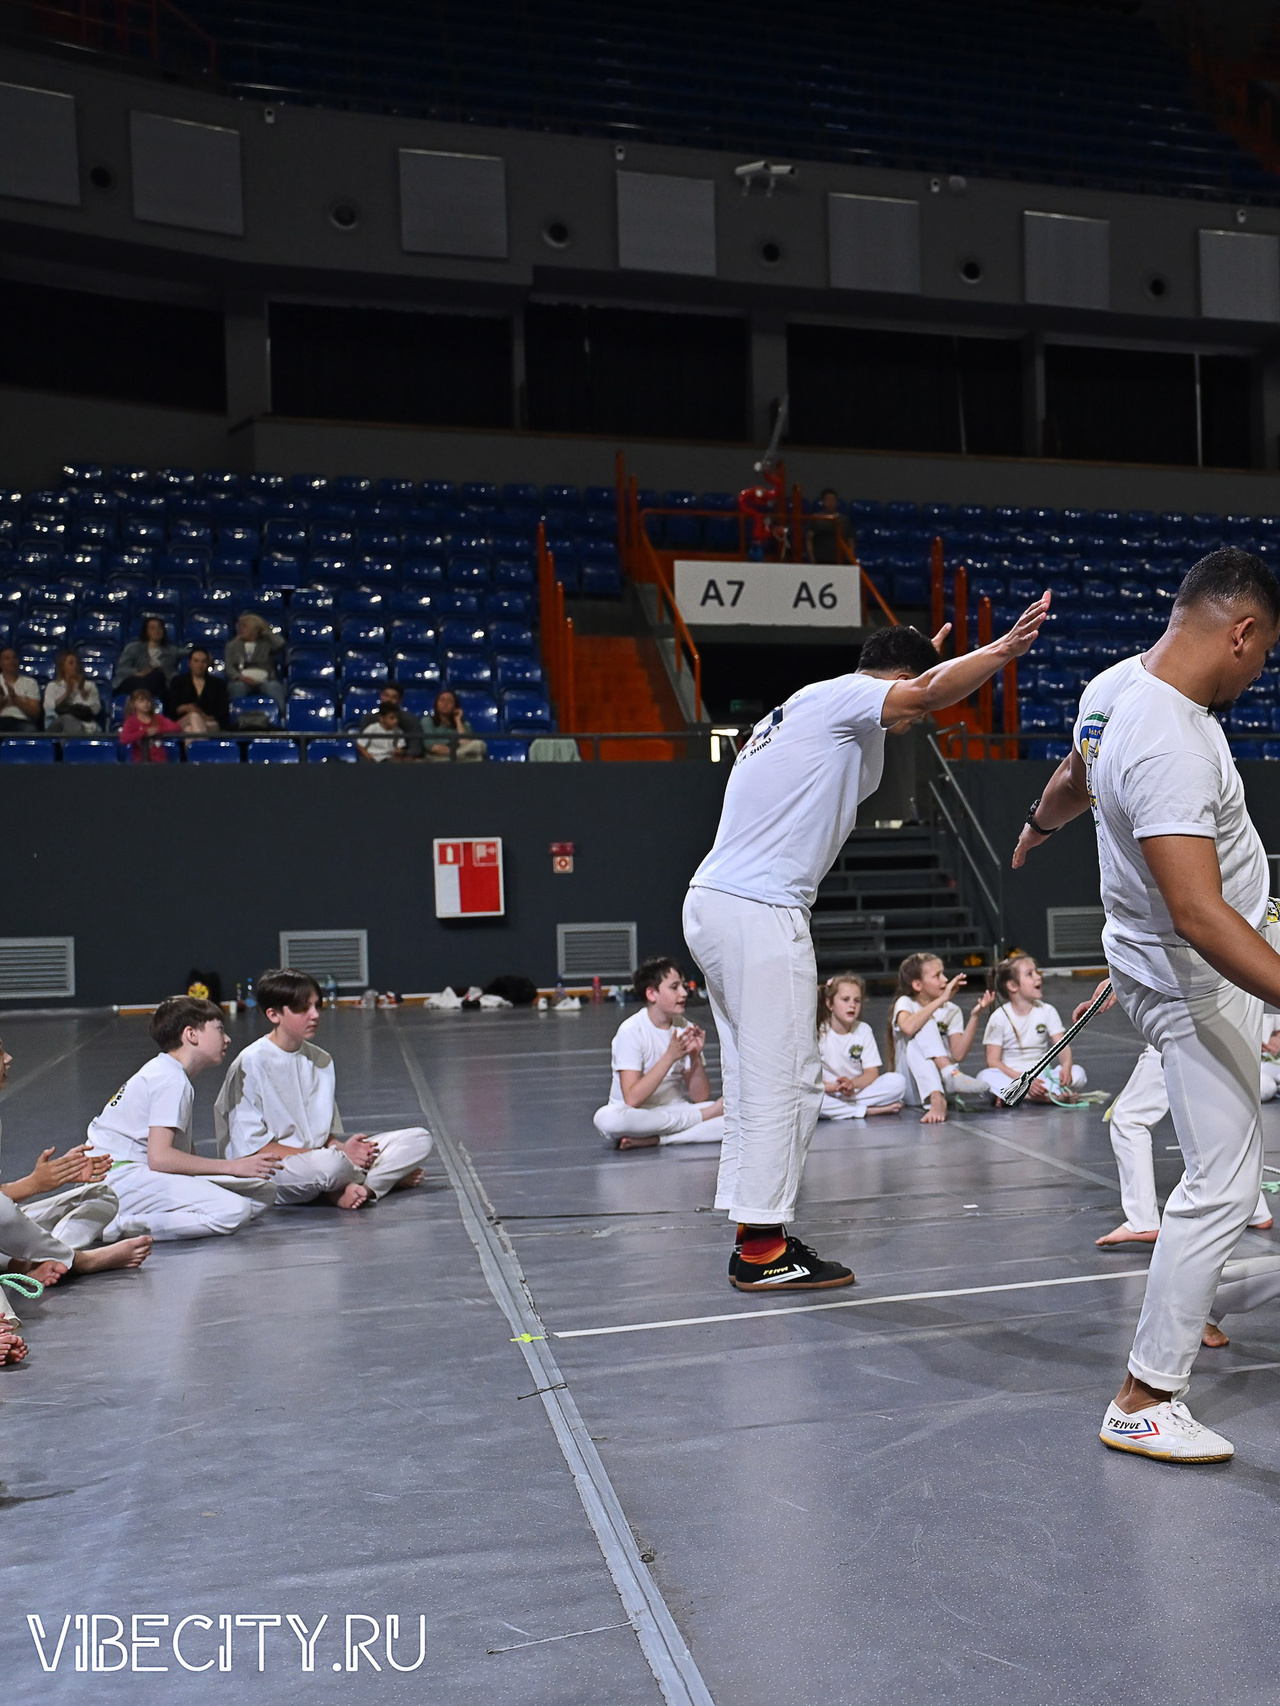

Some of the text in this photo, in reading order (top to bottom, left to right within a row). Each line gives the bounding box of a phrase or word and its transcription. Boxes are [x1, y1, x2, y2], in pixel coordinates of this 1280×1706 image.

[700, 579, 745, 607] A7
[792, 581, 838, 610] A6
[1107, 1417, 1142, 1430] FEIYUE
